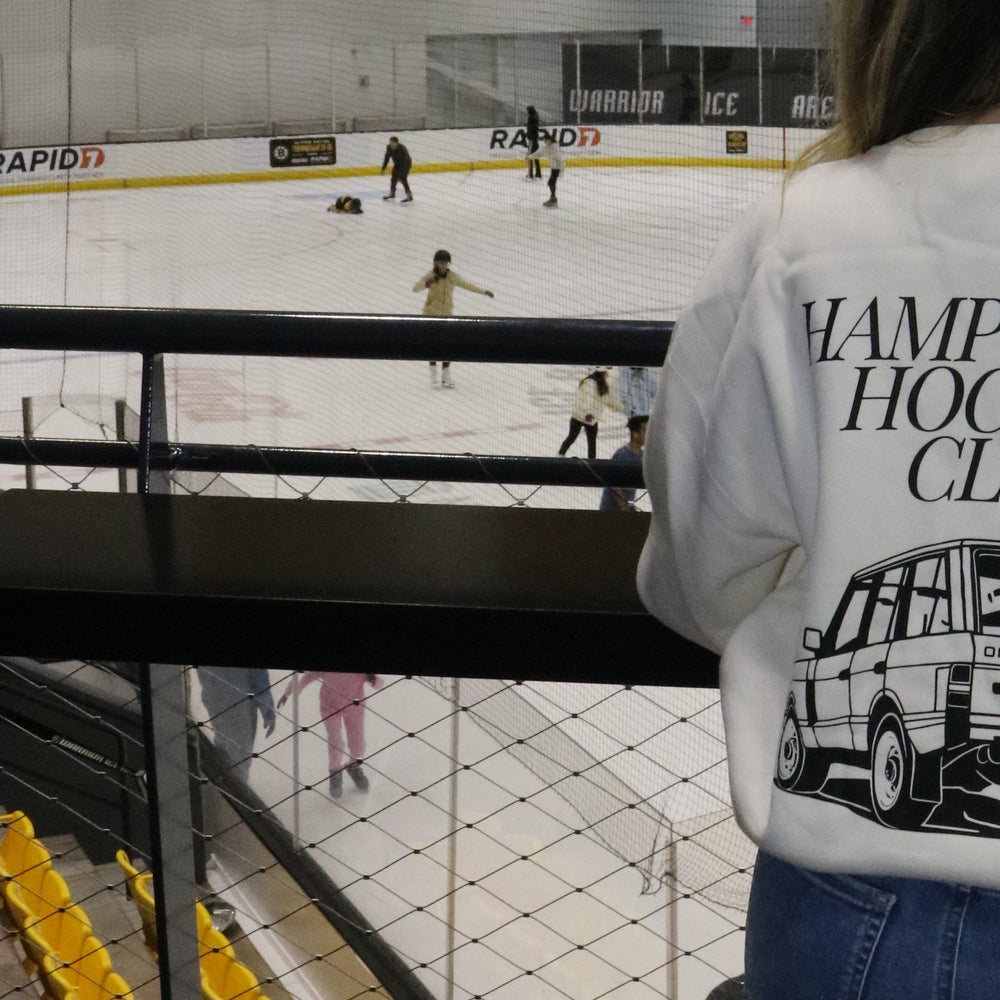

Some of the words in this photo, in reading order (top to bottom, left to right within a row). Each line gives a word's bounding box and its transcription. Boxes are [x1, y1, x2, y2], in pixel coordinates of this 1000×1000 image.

[569, 88, 664, 115] WARRIOR
[704, 92, 740, 116] ICE
[791, 95, 836, 120] ARE
